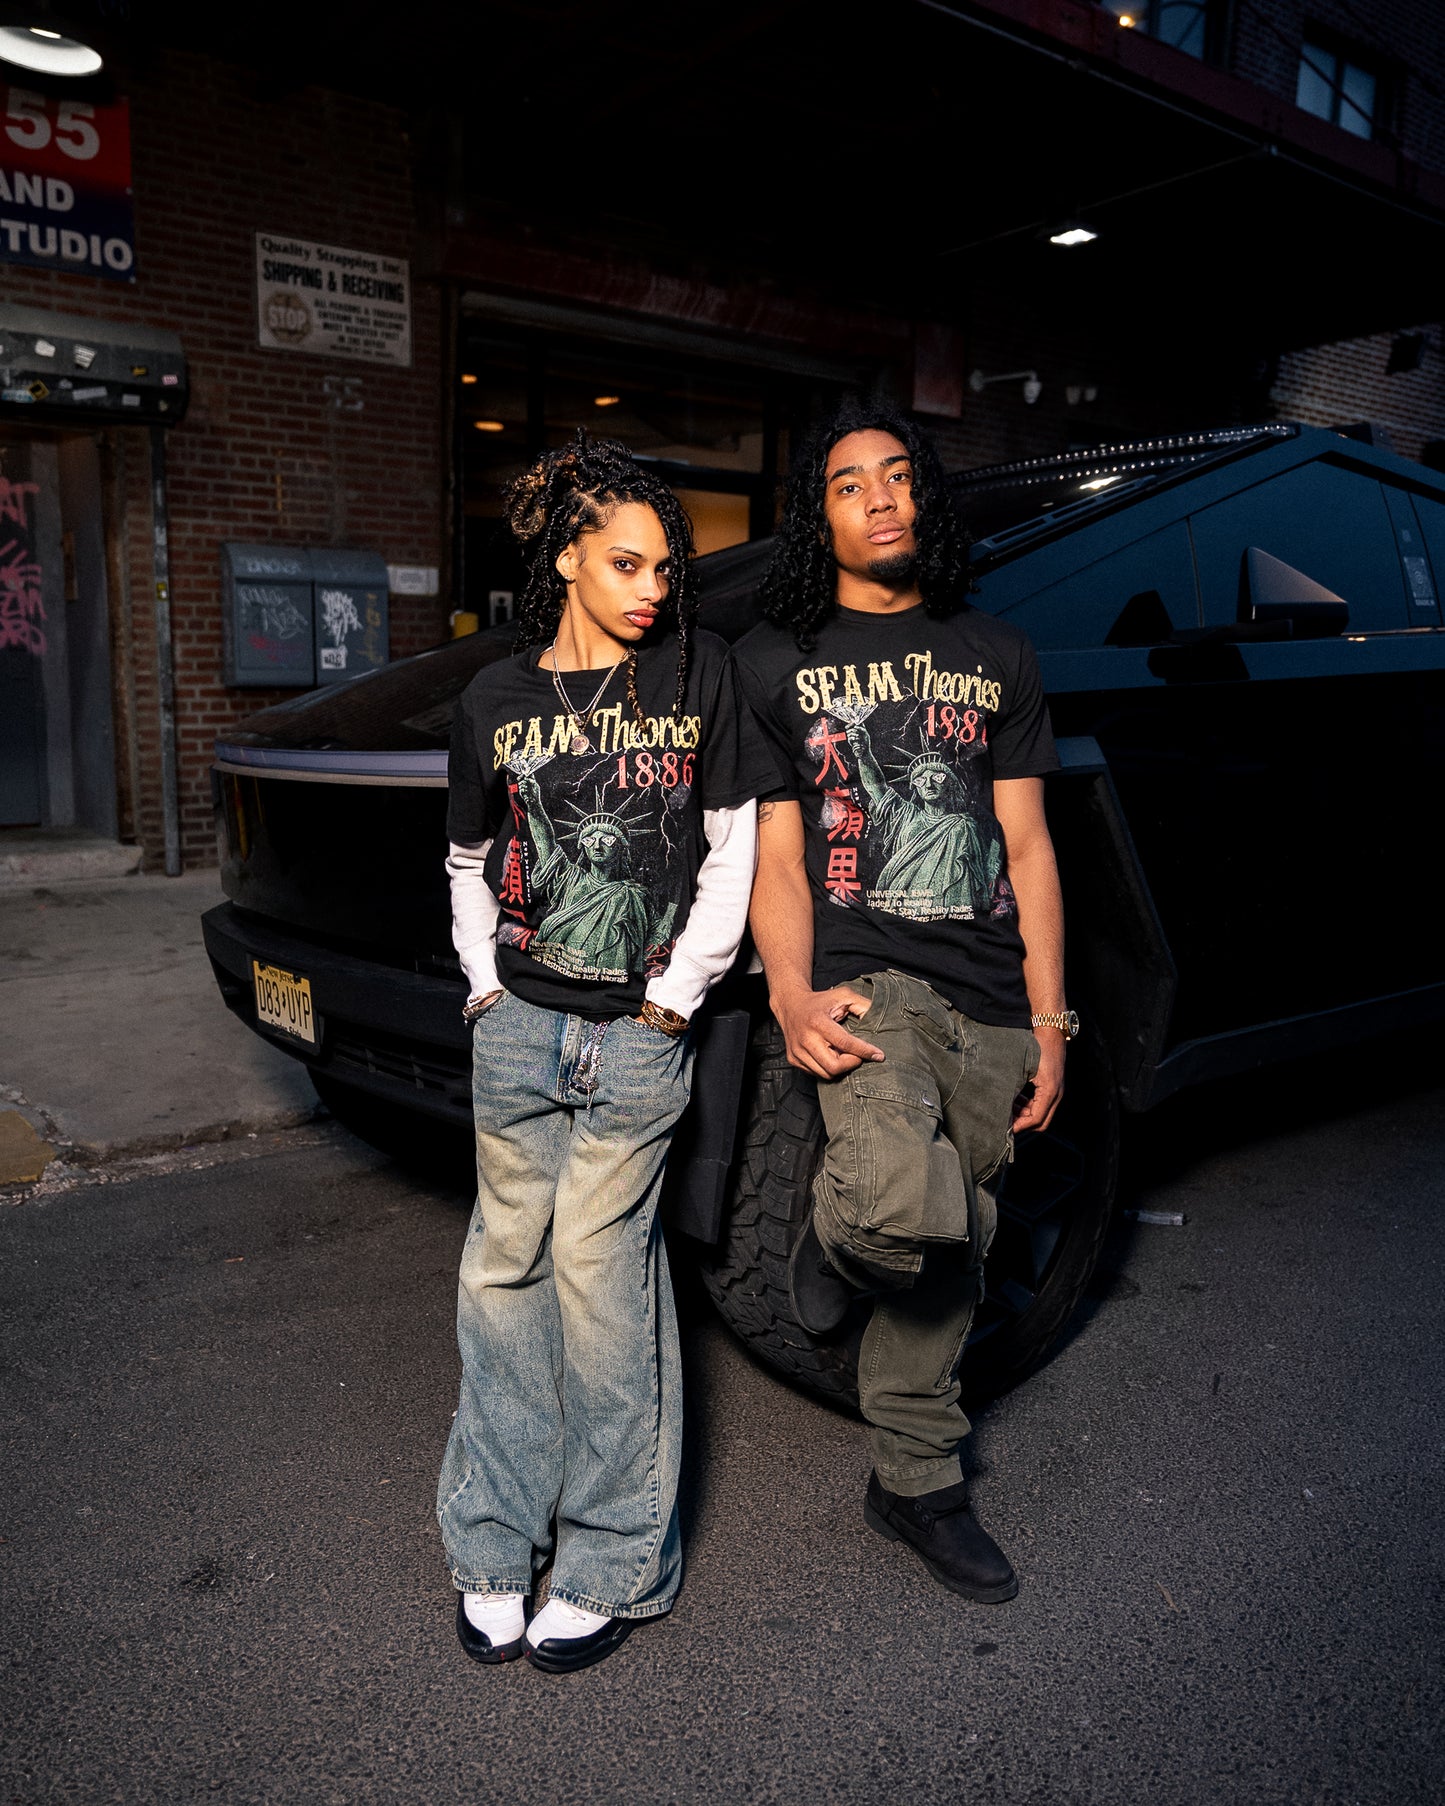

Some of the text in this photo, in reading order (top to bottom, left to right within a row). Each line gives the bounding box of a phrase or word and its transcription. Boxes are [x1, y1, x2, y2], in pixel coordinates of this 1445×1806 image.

[4, 85, 101, 161] 55
[0, 218, 134, 271] TUDIO
[261, 238, 311, 260] Quality
[317, 247, 378, 274] Strapping
[263, 260, 404, 303] SHIPPING & RECEIVING
[268, 304, 306, 331] STOP
[904, 649, 1002, 713] Theories
[592, 701, 701, 754] Theories
[616, 751, 697, 789] 1886
[866, 889, 909, 899] UNIVERSAL
[866, 898, 890, 909] Jaded
[891, 899, 903, 907] To
[920, 904, 949, 915] Reality
[948, 912, 975, 921] Morals
[542, 957, 581, 981] Restrictions
[582, 973, 600, 982] Just
[601, 974, 629, 984] Morals
[572, 963, 601, 976] Reality
